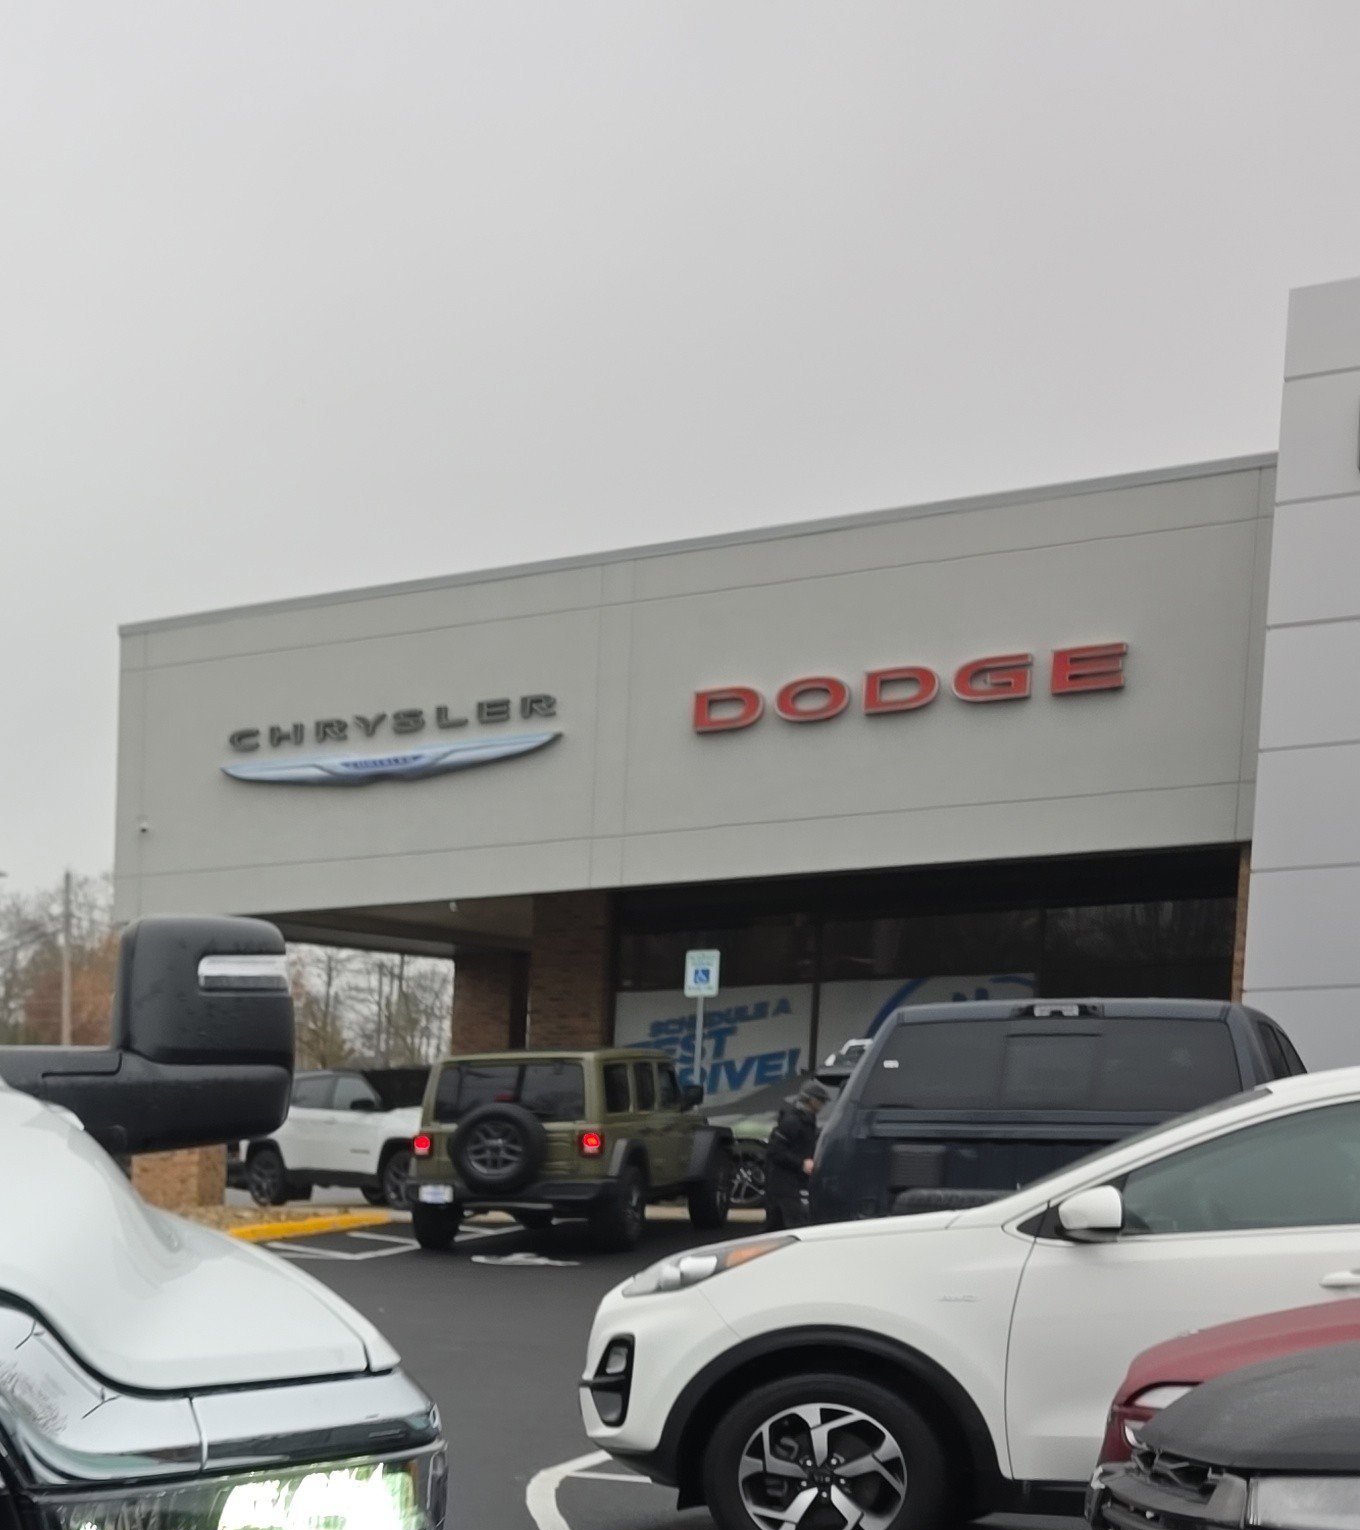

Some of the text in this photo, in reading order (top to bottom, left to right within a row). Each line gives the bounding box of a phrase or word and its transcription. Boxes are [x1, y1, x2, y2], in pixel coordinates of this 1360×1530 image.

[693, 641, 1128, 735] DODGE
[228, 693, 558, 752] CHRYSLER
[772, 998, 793, 1016] A
